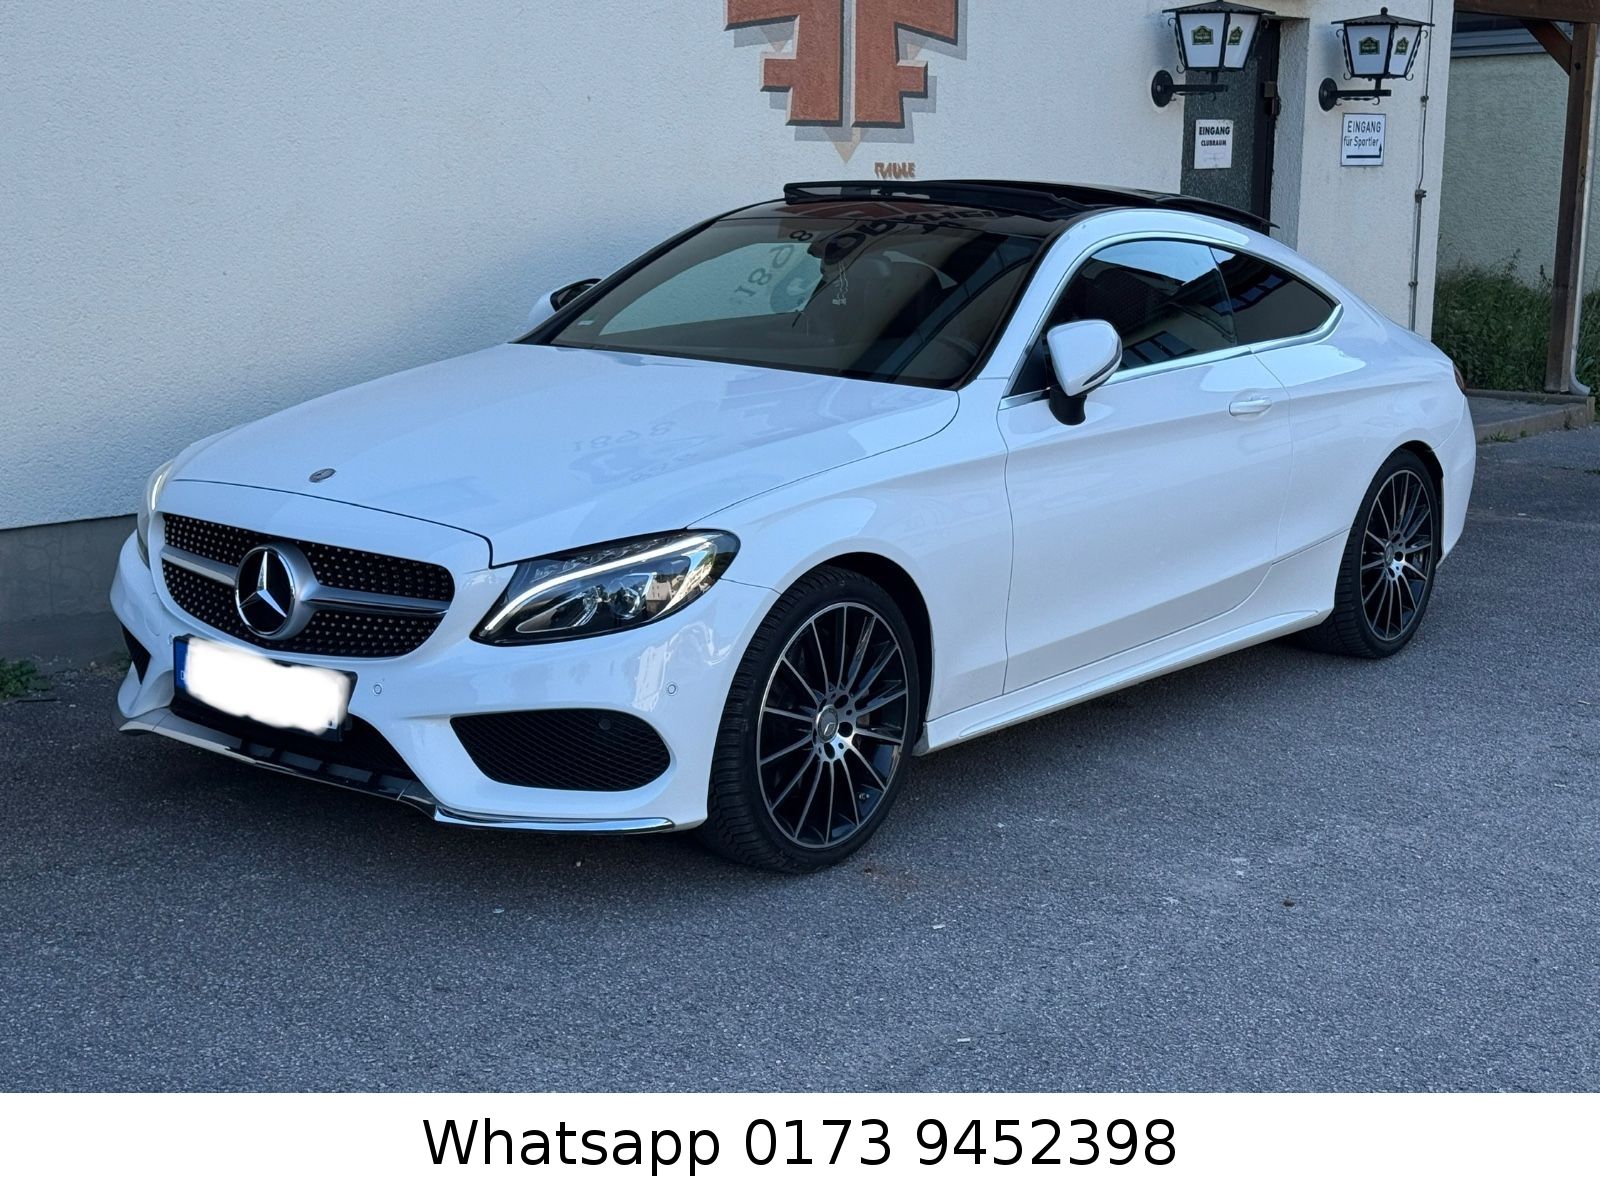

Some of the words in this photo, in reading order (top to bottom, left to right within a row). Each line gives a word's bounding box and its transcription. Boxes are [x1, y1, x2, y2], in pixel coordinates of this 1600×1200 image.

[1199, 126, 1231, 136] EINGANG
[1347, 120, 1381, 133] EINGANG
[1200, 139, 1227, 147] CLUBRAUM
[1344, 135, 1353, 147] für
[1353, 135, 1379, 150] Sportler
